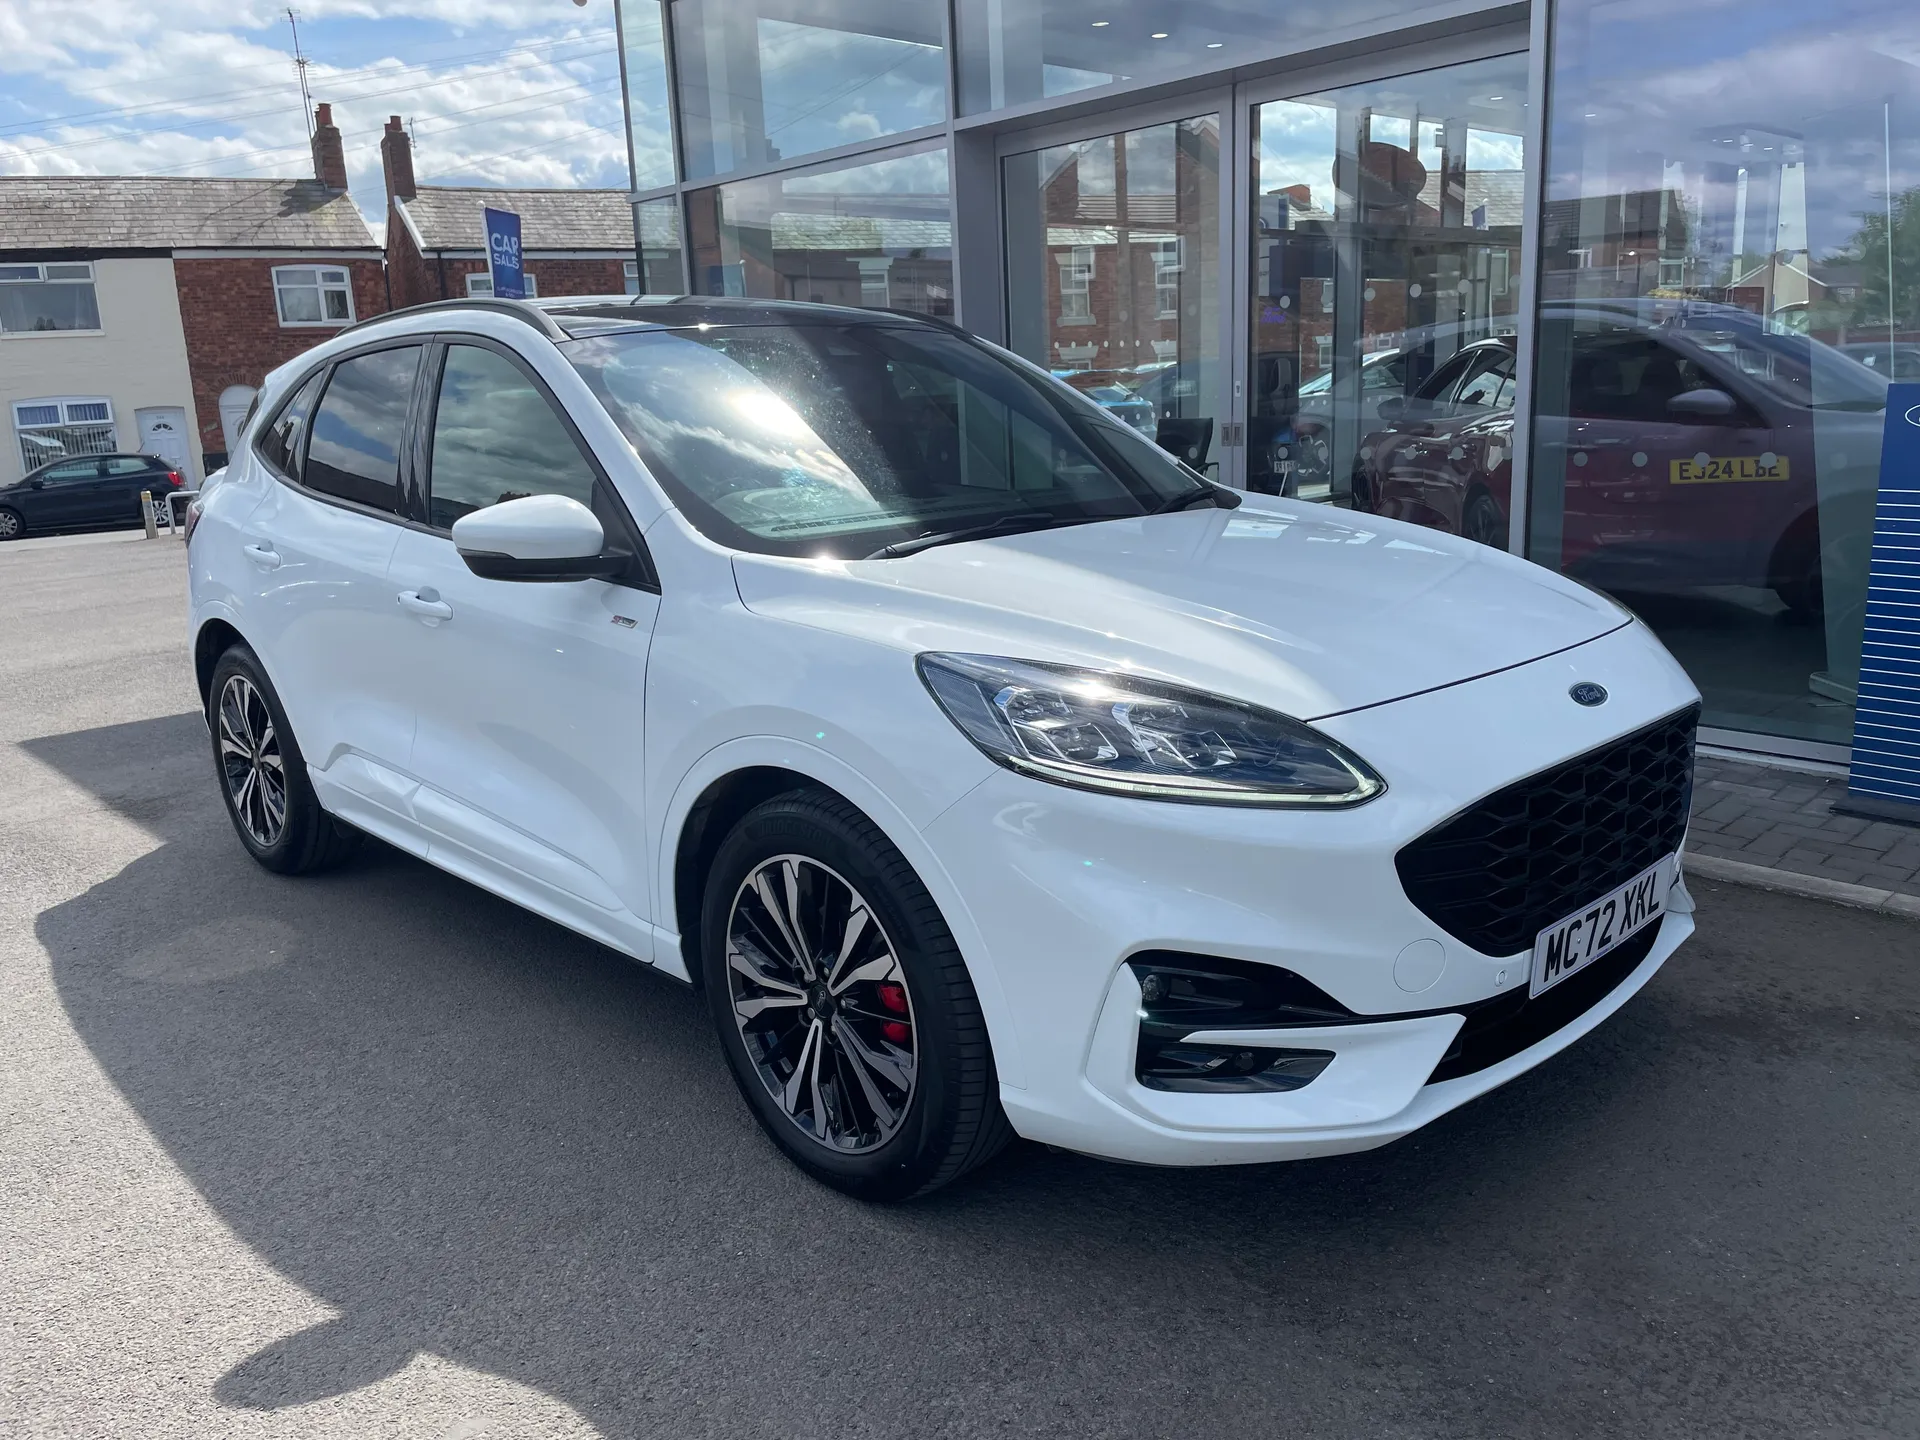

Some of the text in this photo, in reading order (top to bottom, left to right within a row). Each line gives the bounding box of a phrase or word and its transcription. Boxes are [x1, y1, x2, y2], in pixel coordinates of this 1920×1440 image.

[491, 232, 519, 256] CAR
[1577, 686, 1602, 702] Ford
[1543, 871, 1660, 983] MC72 XKL
